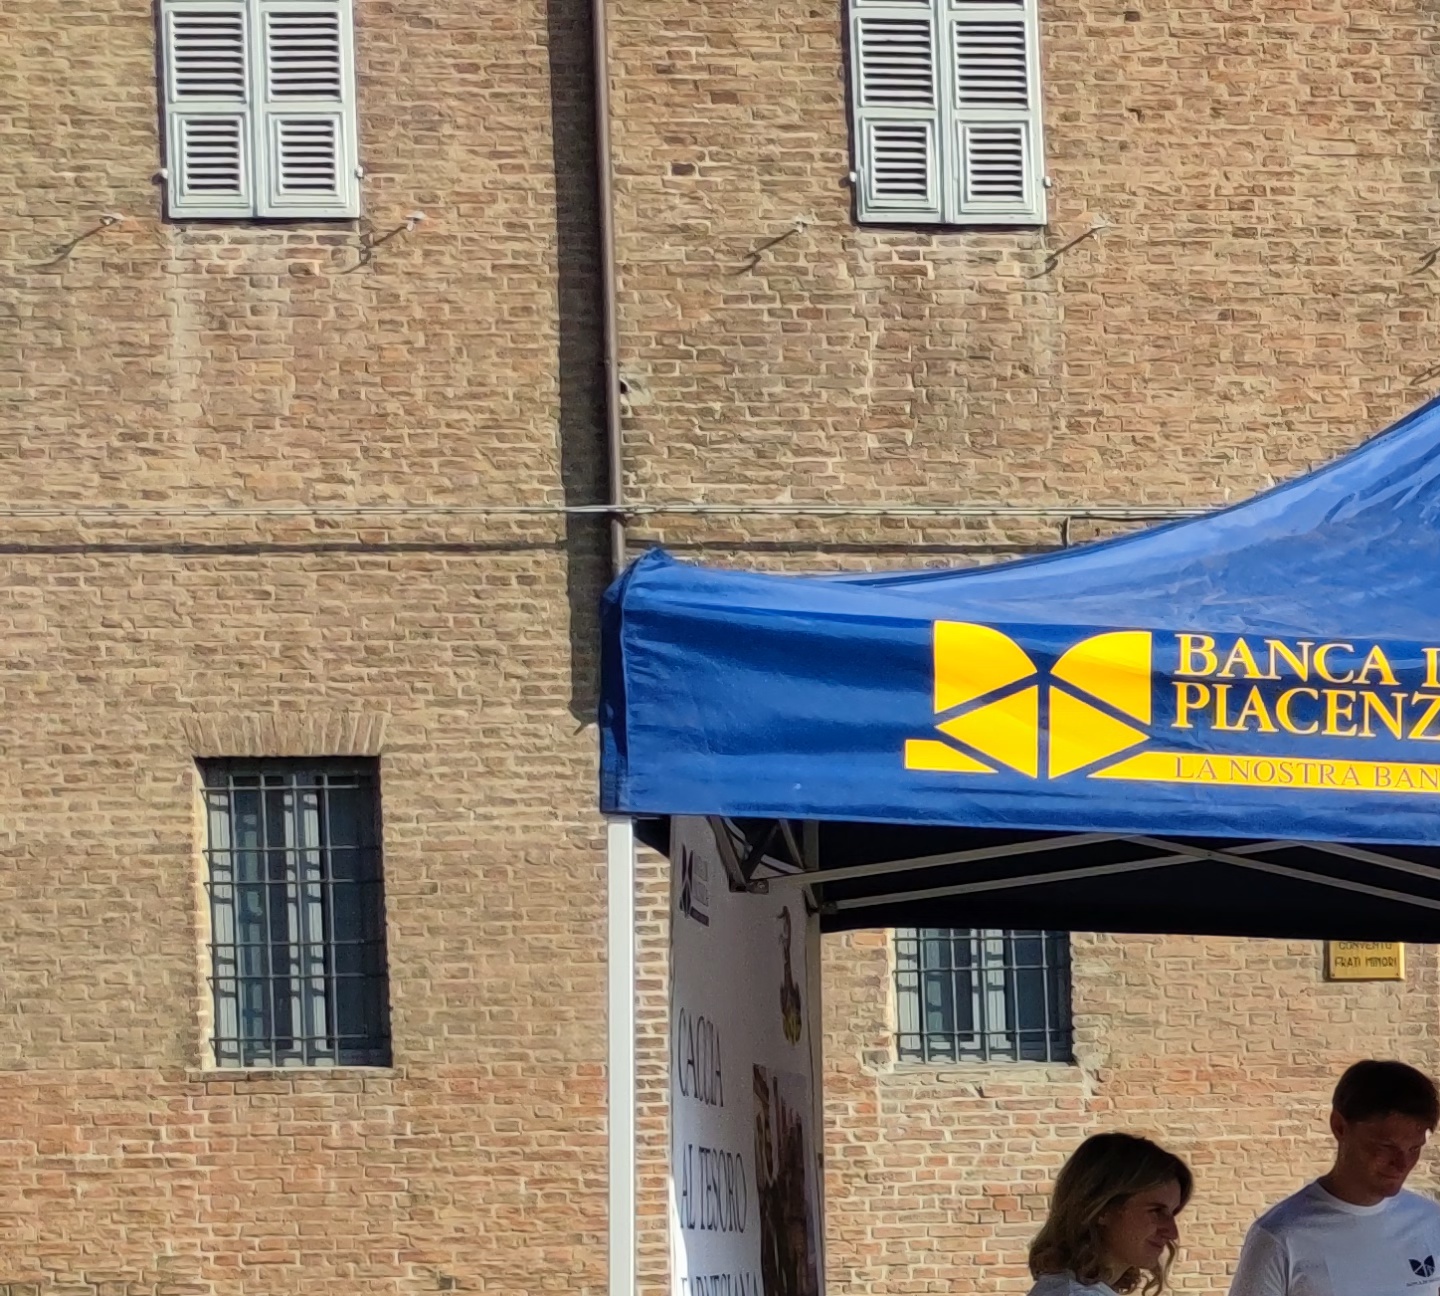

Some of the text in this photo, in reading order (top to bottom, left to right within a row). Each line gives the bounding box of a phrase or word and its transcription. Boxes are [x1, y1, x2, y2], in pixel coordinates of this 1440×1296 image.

[1174, 633, 1401, 686] BANCA
[1174, 755, 1218, 780] LA
[1229, 759, 1361, 786] NOSTRA
[1334, 956, 1362, 968] FRATI
[678, 1007, 724, 1107] CACCIA
[680, 1143, 747, 1234] AL TESORO
